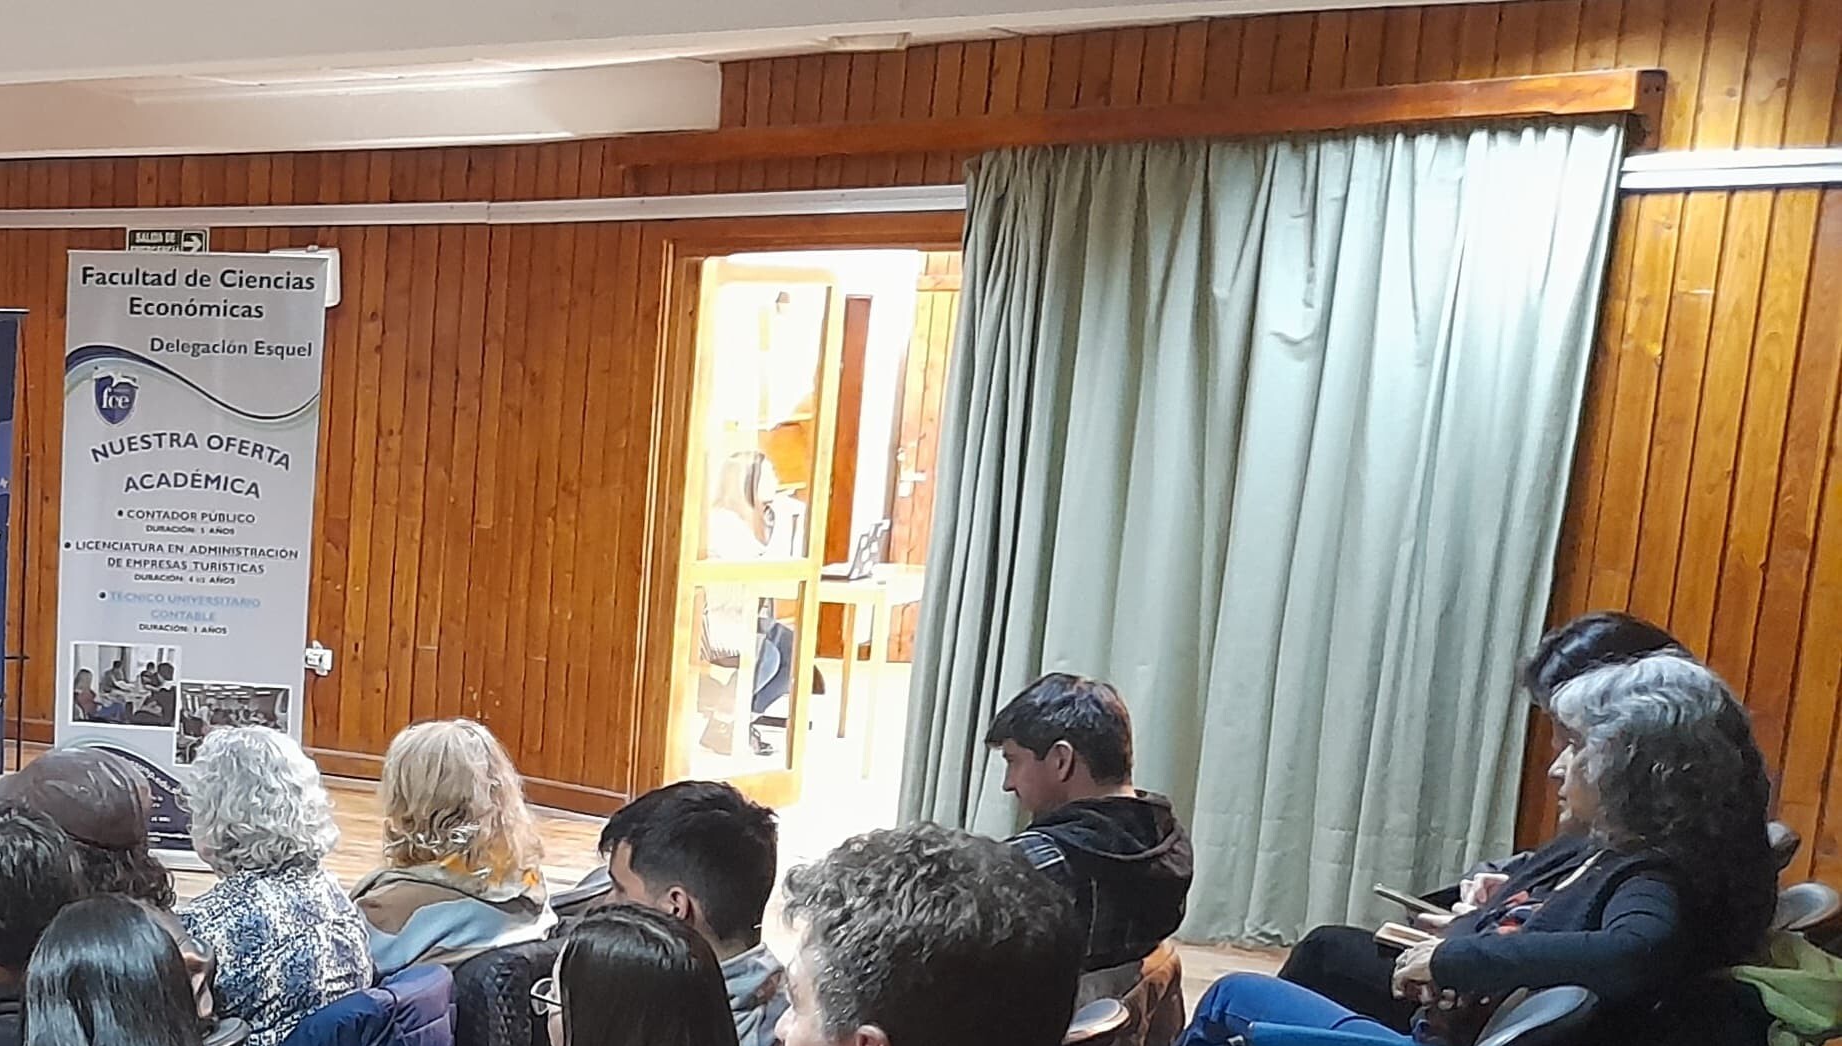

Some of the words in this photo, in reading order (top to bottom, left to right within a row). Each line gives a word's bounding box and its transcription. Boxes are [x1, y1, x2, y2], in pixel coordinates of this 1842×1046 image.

[81, 266, 177, 287] Facultad
[184, 269, 211, 288] de
[219, 269, 315, 291] Ciencias
[128, 296, 264, 319] Económicas
[150, 337, 248, 358] Delegación
[254, 341, 312, 361] Esquel
[91, 432, 198, 463] NUESTRA
[207, 434, 291, 471] OFERTA
[124, 469, 261, 499] ACADÉMICA
[126, 510, 197, 521] CONTADOR
[76, 541, 164, 553] LICENCIATURA
[168, 544, 184, 554] EN
[108, 557, 122, 567] DE
[126, 558, 188, 570] EMPRESAS
